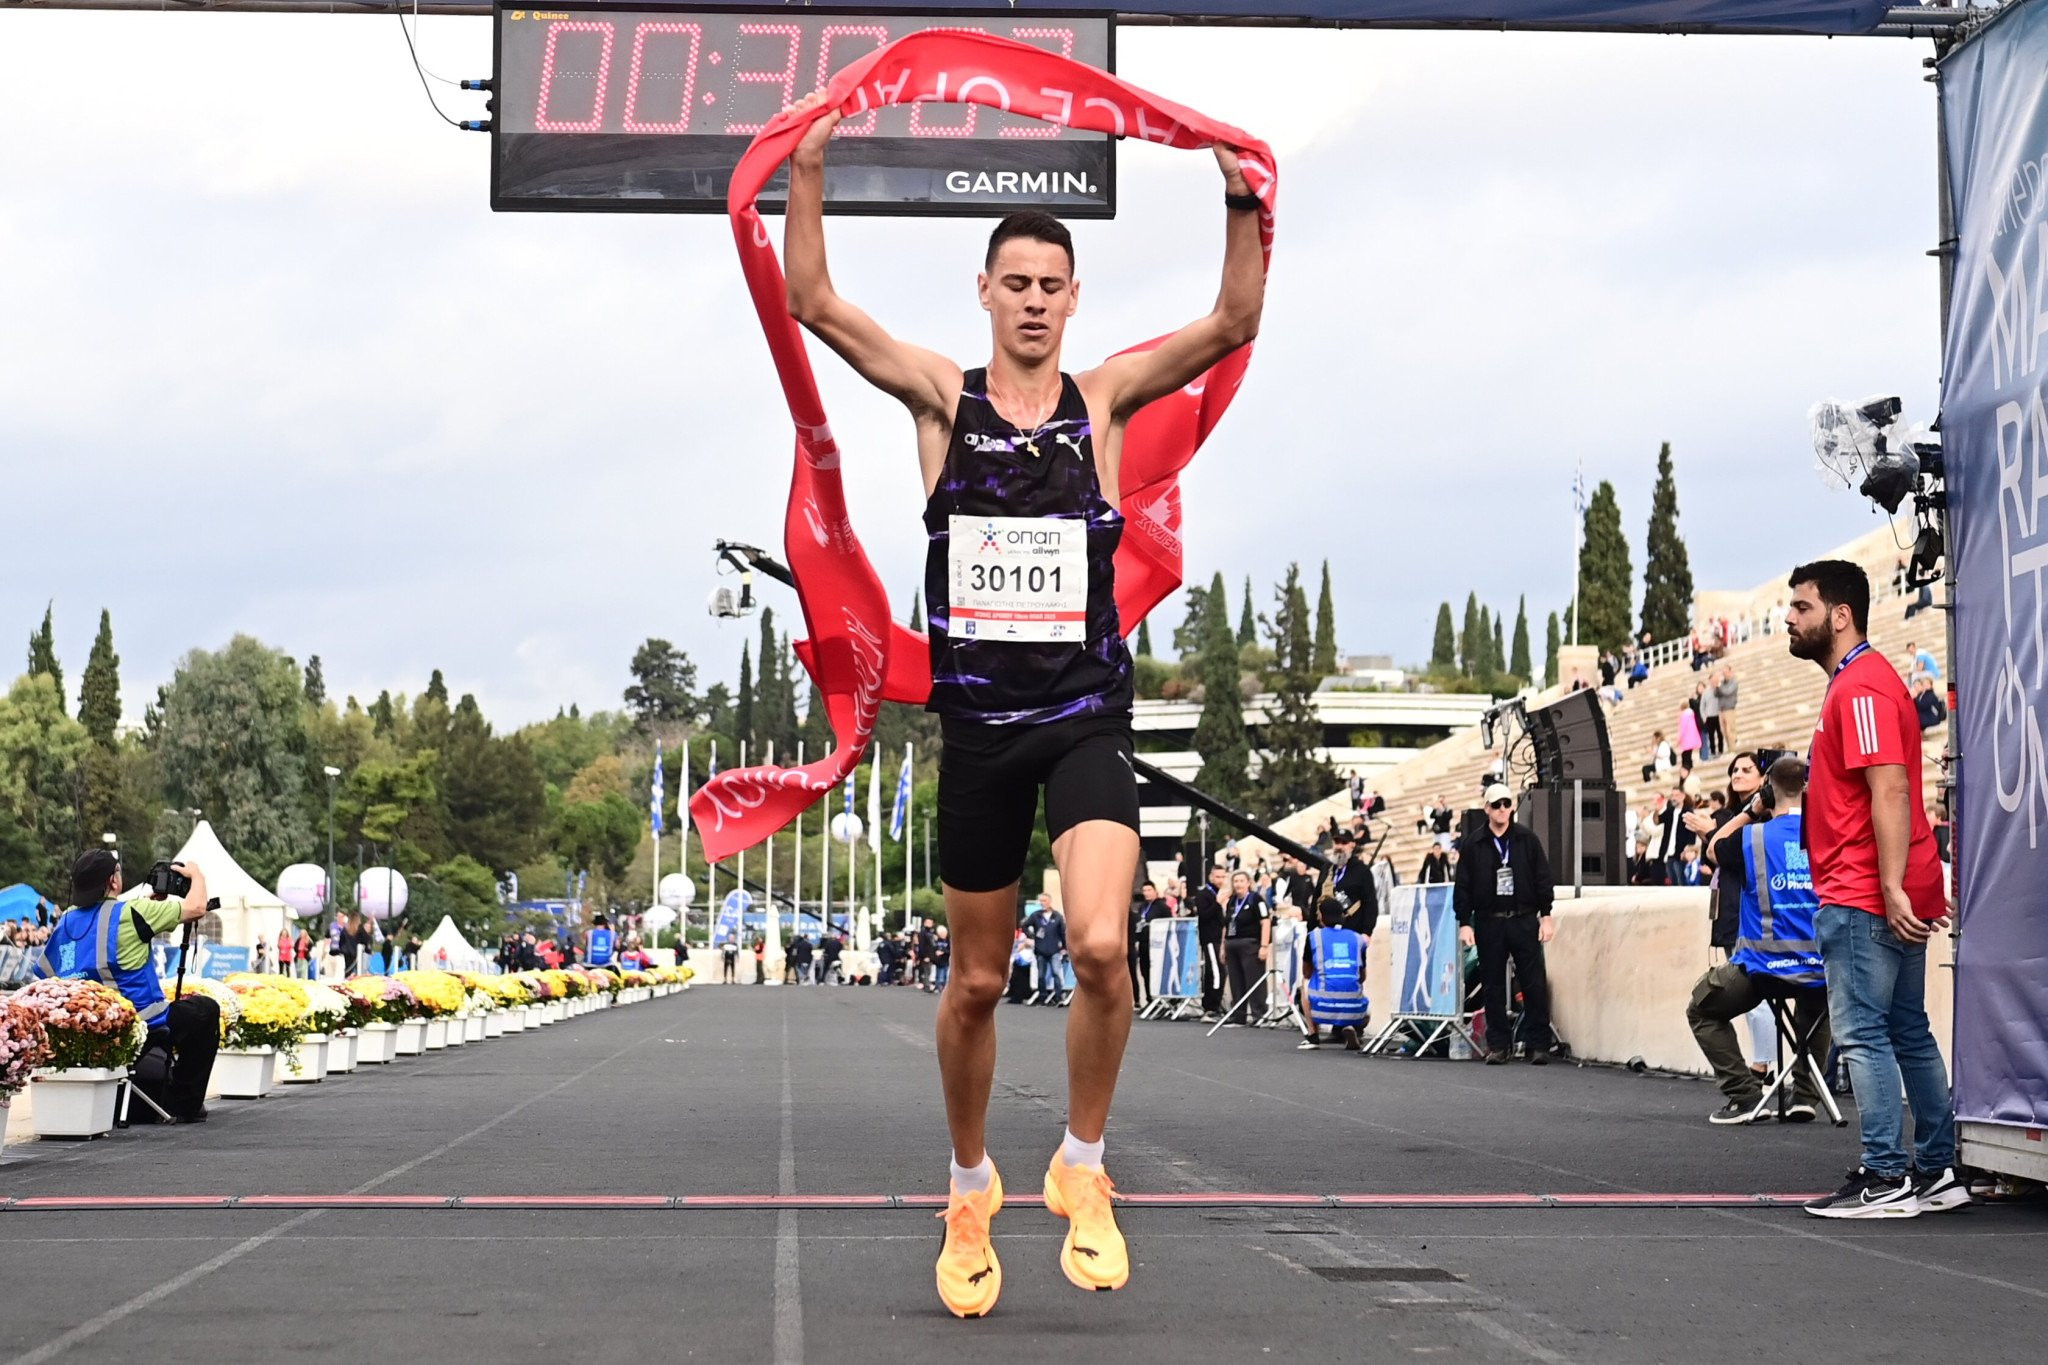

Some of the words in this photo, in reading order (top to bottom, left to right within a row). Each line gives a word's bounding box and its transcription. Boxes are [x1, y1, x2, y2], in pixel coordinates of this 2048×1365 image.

[1041, 86, 1186, 146] ACE
[945, 171, 1088, 194] GARMIN
[971, 564, 1061, 593] 30101
